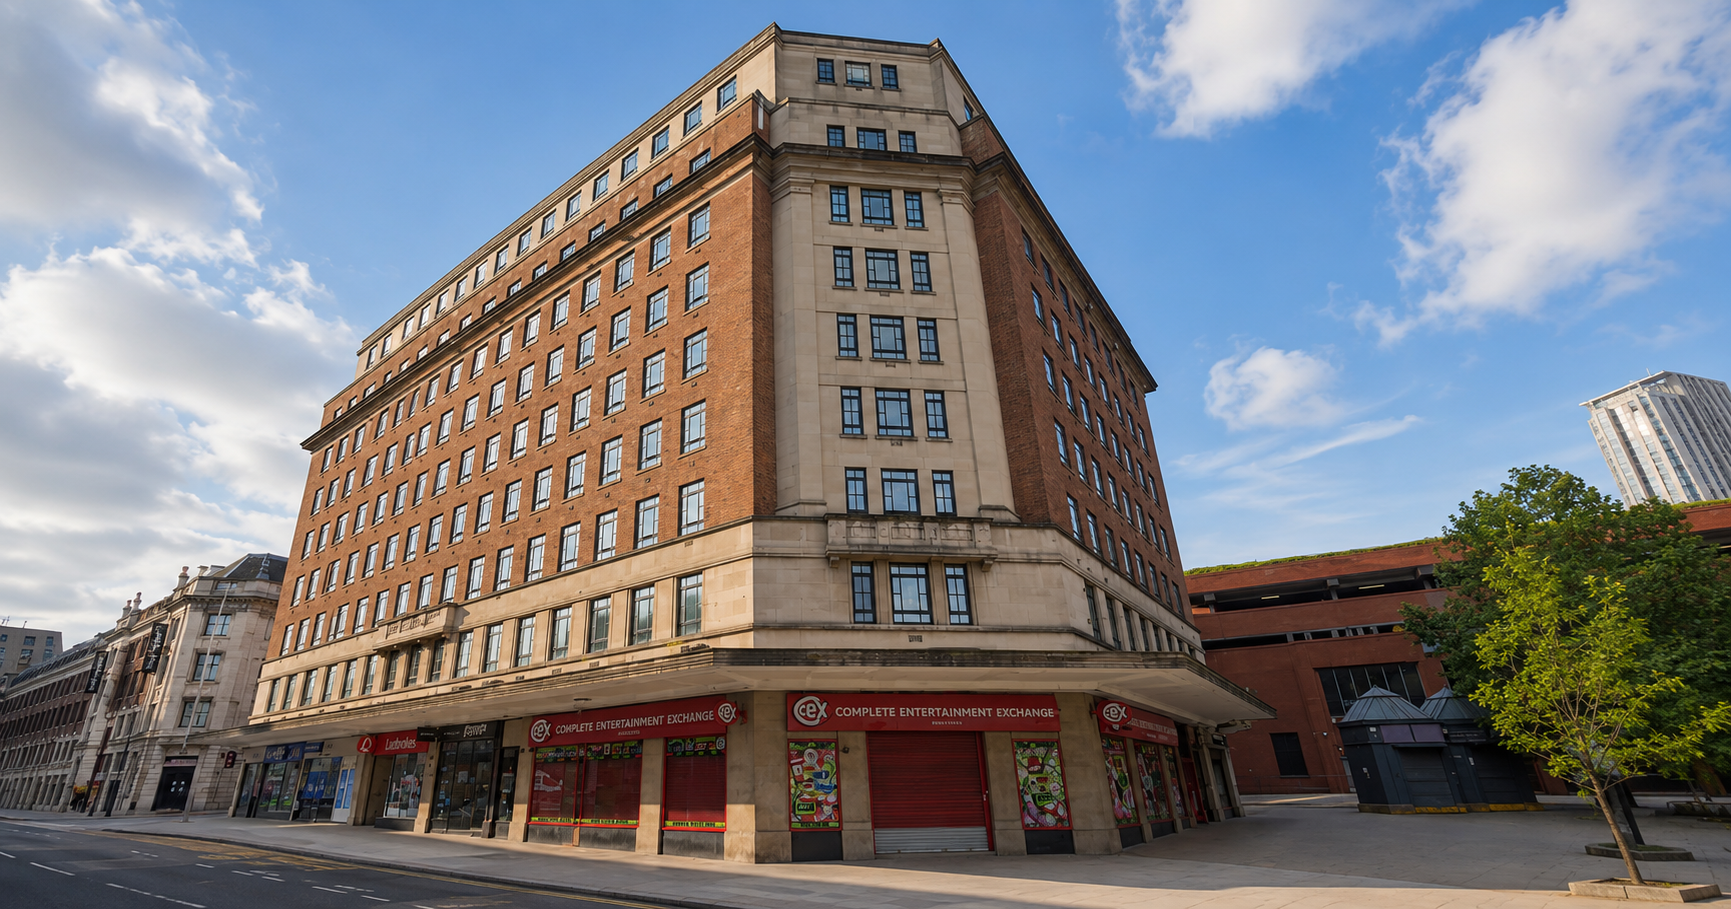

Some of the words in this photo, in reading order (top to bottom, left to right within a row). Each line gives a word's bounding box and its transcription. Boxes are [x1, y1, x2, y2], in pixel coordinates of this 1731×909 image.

[835, 706, 896, 717] COMPLETE
[899, 707, 993, 718] ENTERTAINMENT
[996, 708, 1055, 718] EXCHANGE
[555, 722, 594, 735] COMPLETE
[595, 715, 664, 731] ENTERTAINMENT
[667, 710, 715, 724] EXCHANGE
